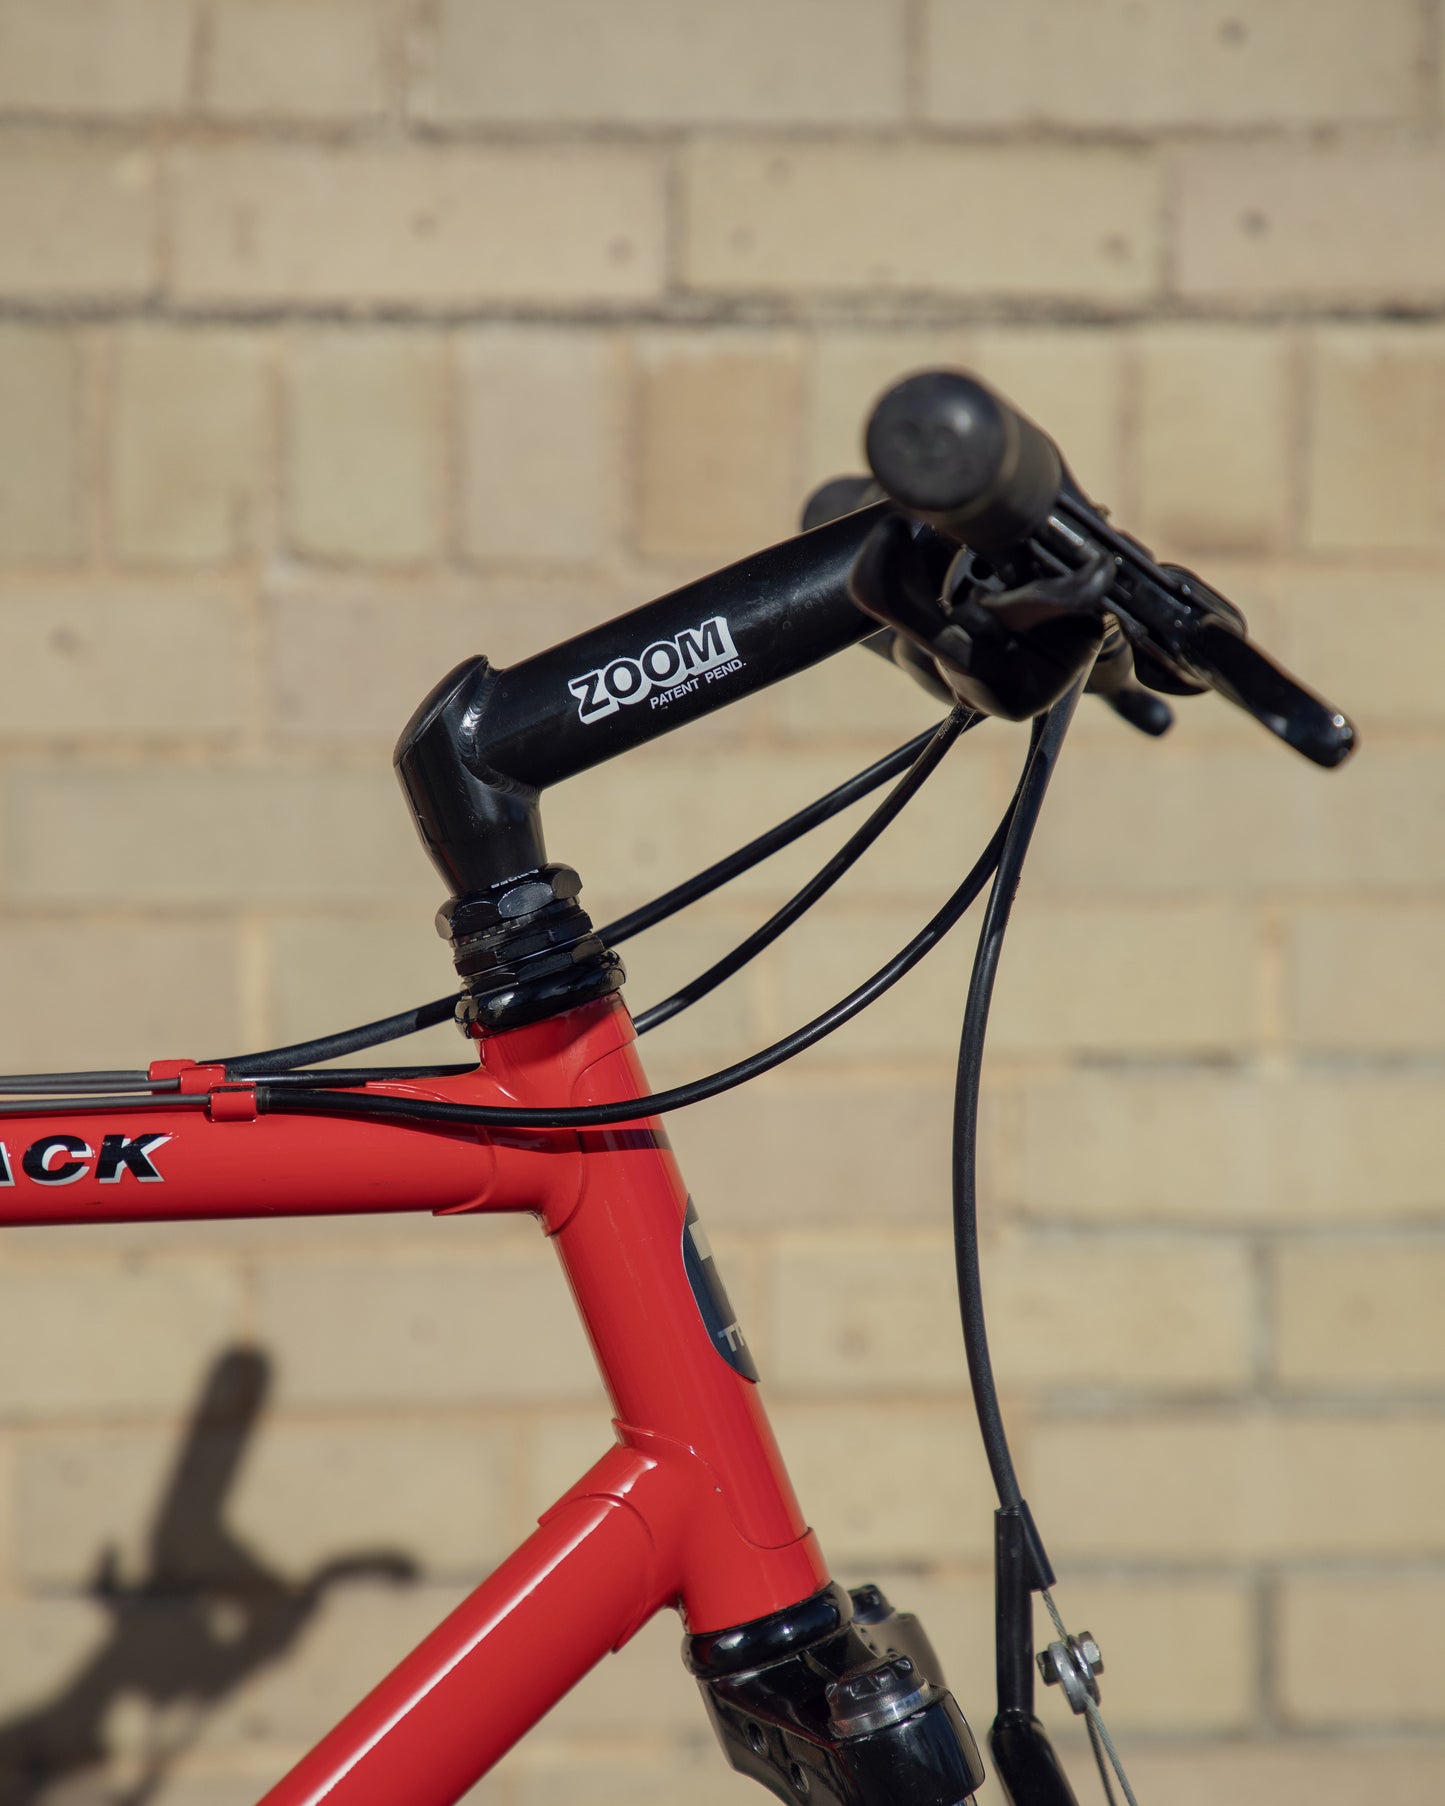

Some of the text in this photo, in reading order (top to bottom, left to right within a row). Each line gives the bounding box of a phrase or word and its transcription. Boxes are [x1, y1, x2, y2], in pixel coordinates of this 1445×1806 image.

[568, 616, 738, 725] ZOOM
[650, 658, 747, 709] PATENT PEND.
[0, 1133, 173, 1186] CK
